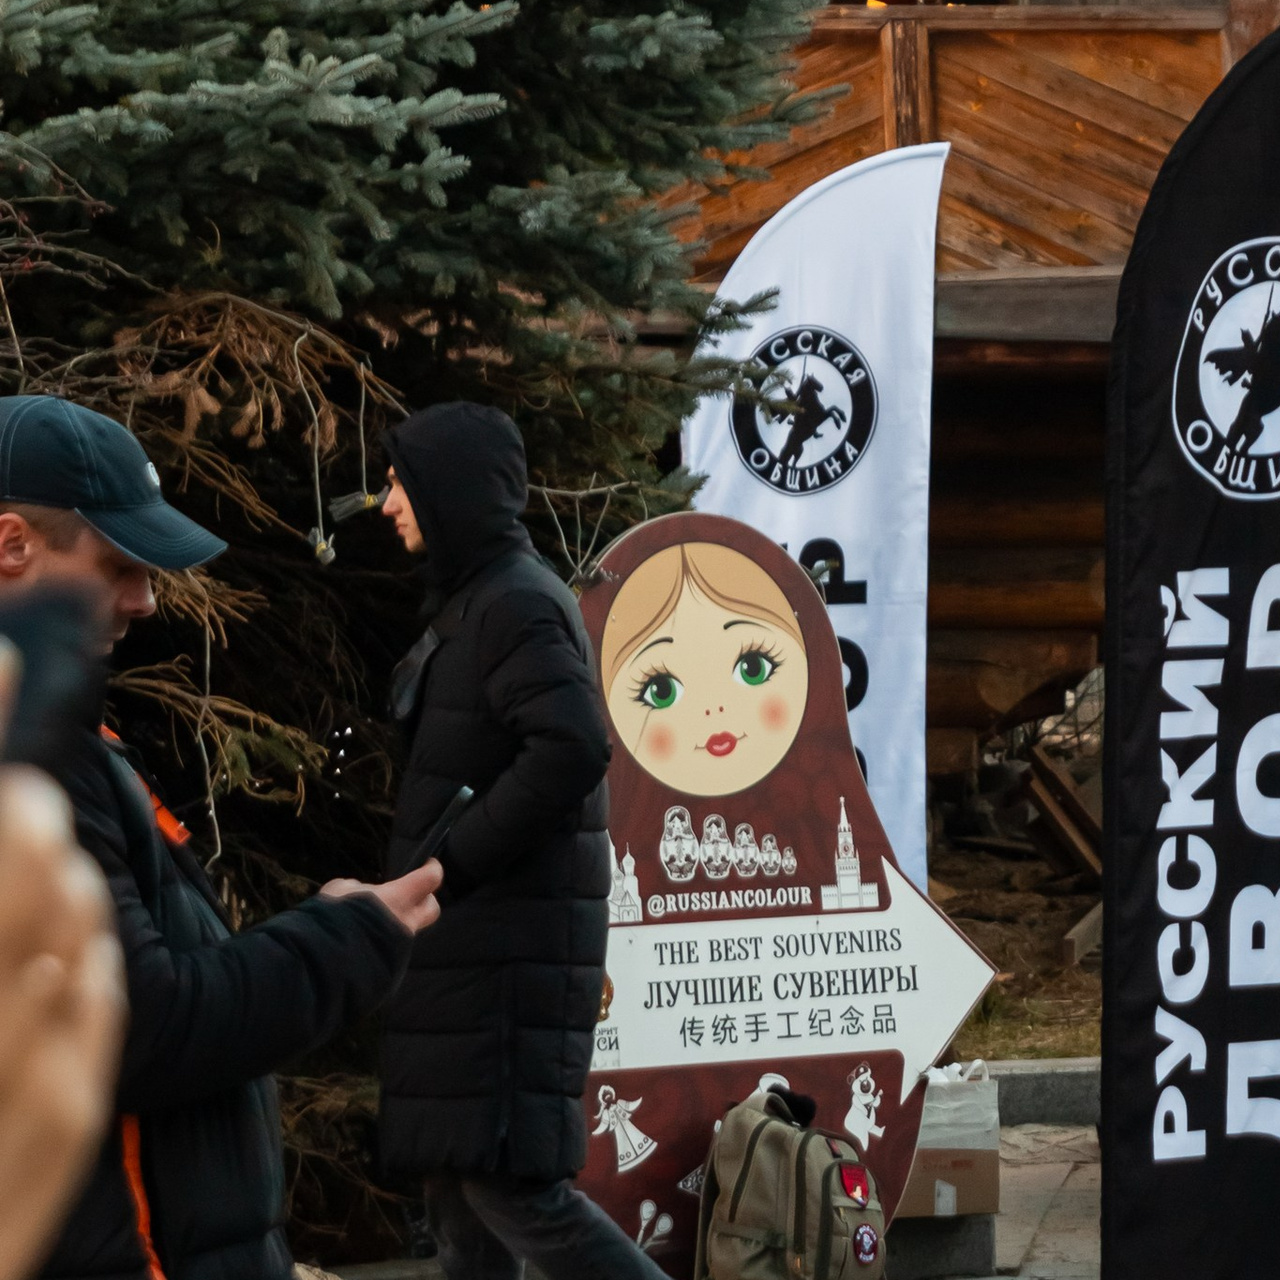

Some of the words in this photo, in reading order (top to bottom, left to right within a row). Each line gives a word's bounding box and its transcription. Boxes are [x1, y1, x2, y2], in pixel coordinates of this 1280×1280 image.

[750, 440, 859, 491] ОБЩИНА
[1153, 567, 1230, 1161] РУССКИЙ
[647, 886, 813, 917] @RUSSIANCOLOUR
[654, 940, 700, 966] THE
[708, 936, 763, 963] BEST
[772, 928, 903, 959] SOUVENIRS
[643, 974, 763, 1010] ЛУЧШИЕ
[772, 964, 919, 1002] СУВЕНИРЫ
[596, 1036, 620, 1051] СИ
[679, 1003, 897, 1048] 传统手工纪念品
